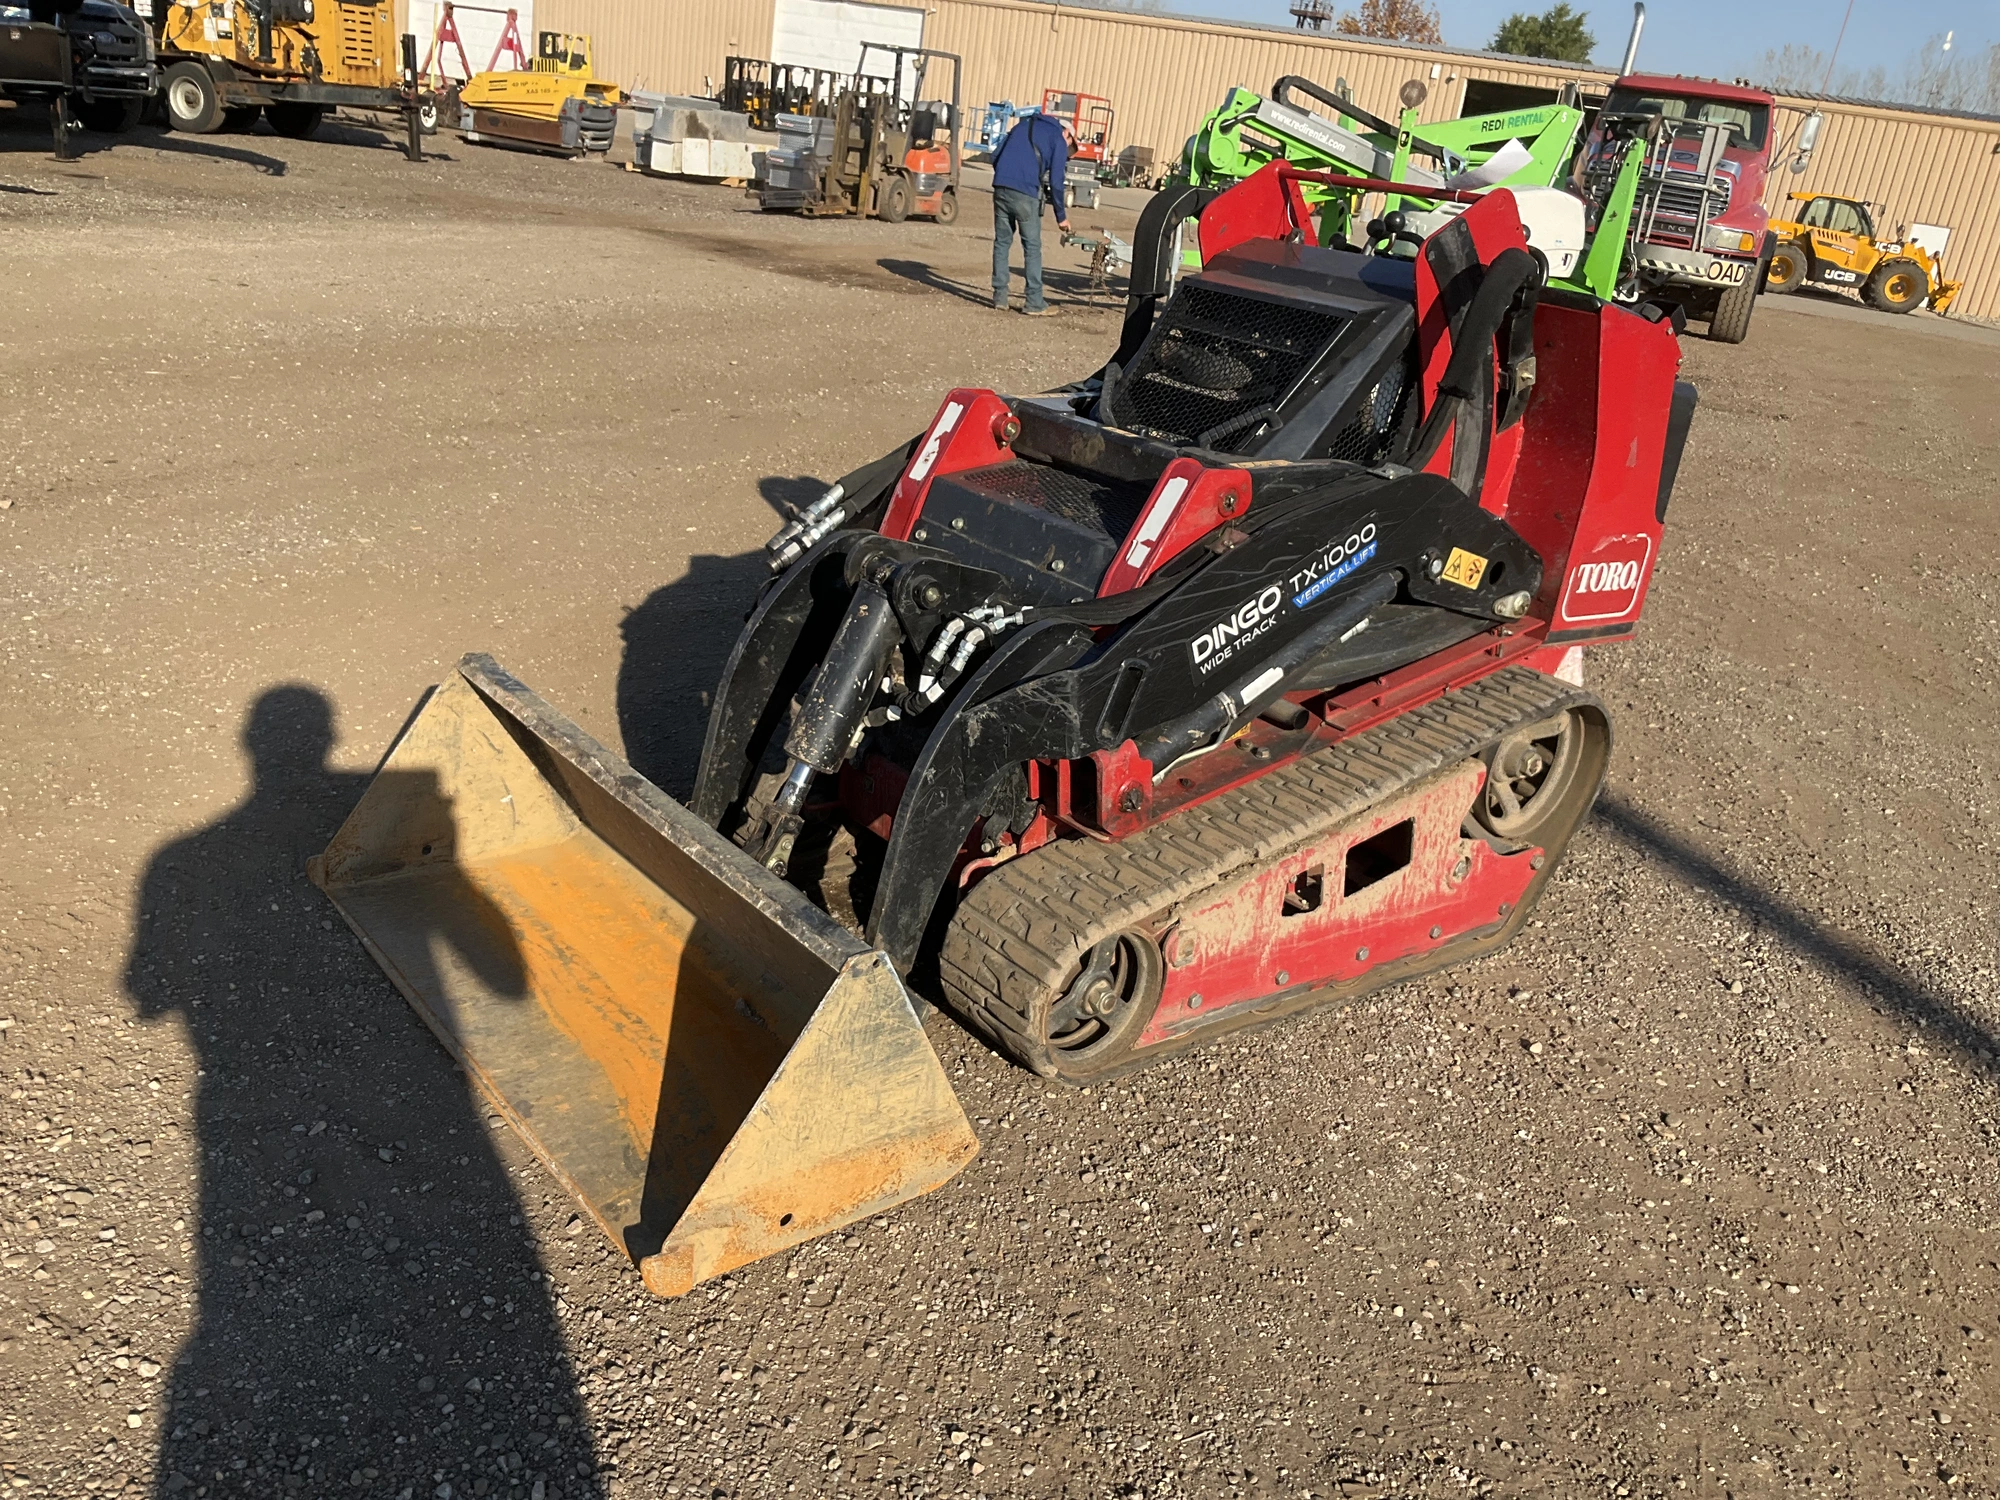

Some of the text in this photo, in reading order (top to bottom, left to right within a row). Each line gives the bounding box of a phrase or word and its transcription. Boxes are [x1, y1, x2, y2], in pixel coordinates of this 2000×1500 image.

[1270, 108, 1347, 153] www.redirental.com
[1481, 111, 1544, 133] REDI RENTAL
[1874, 241, 1902, 255] JCB
[1706, 260, 1746, 283] OAD
[1824, 269, 1856, 283] JCB
[1295, 543, 1377, 605] VERTICAL LIFT
[1575, 560, 1638, 594] TORO
[1191, 585, 1282, 664] DINGO
[1200, 614, 1277, 675] WIDE TRACK
